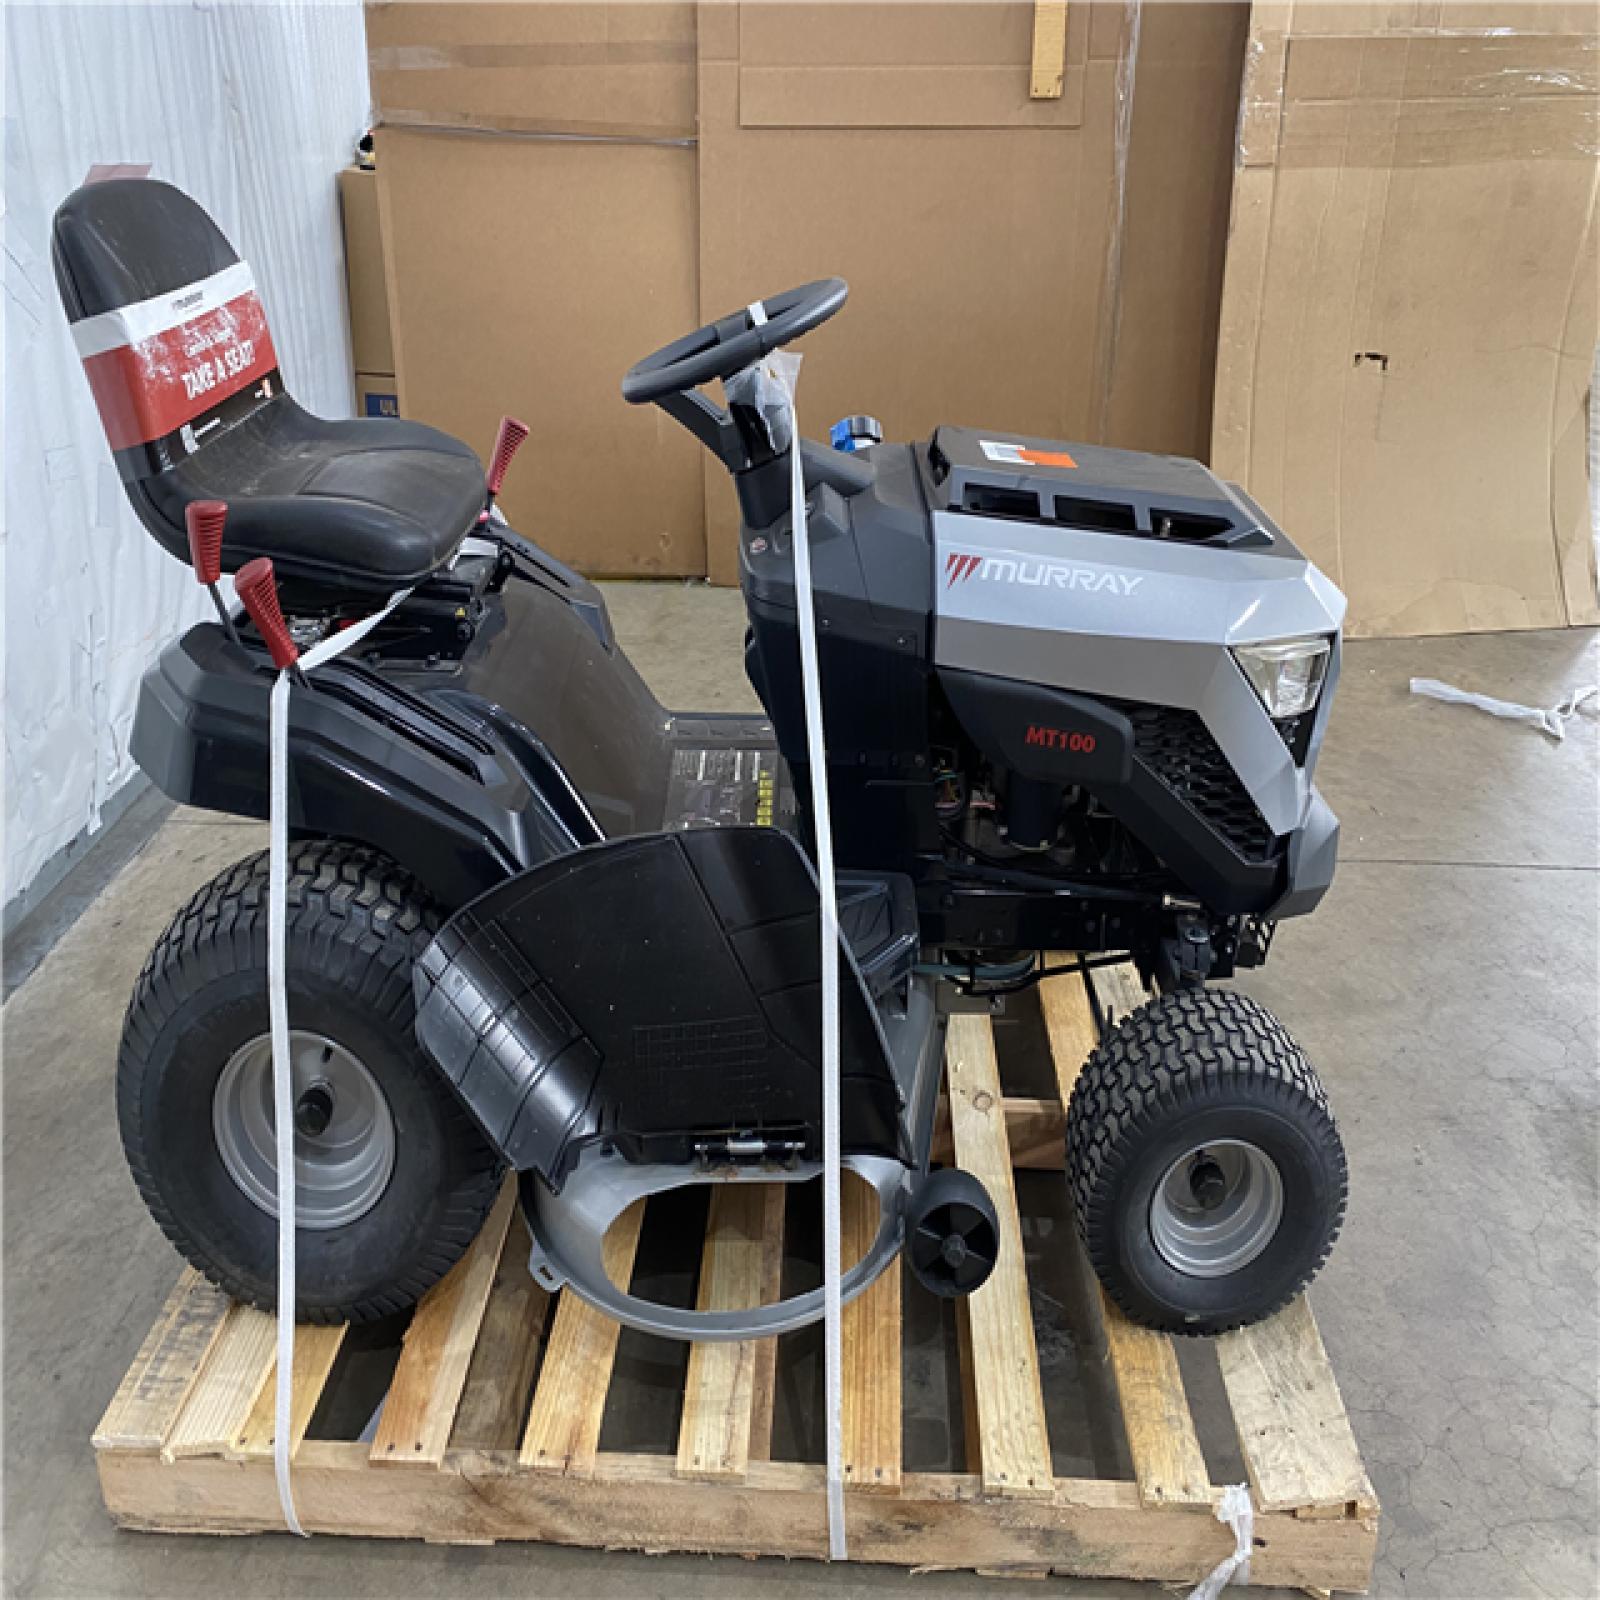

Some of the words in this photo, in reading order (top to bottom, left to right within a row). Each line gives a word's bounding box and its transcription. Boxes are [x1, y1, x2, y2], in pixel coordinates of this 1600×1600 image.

[181, 363, 215, 400] TAKE
[214, 357, 227, 383] A
[980, 558, 1143, 595] MURRAY
[1025, 726, 1096, 753] MT100
